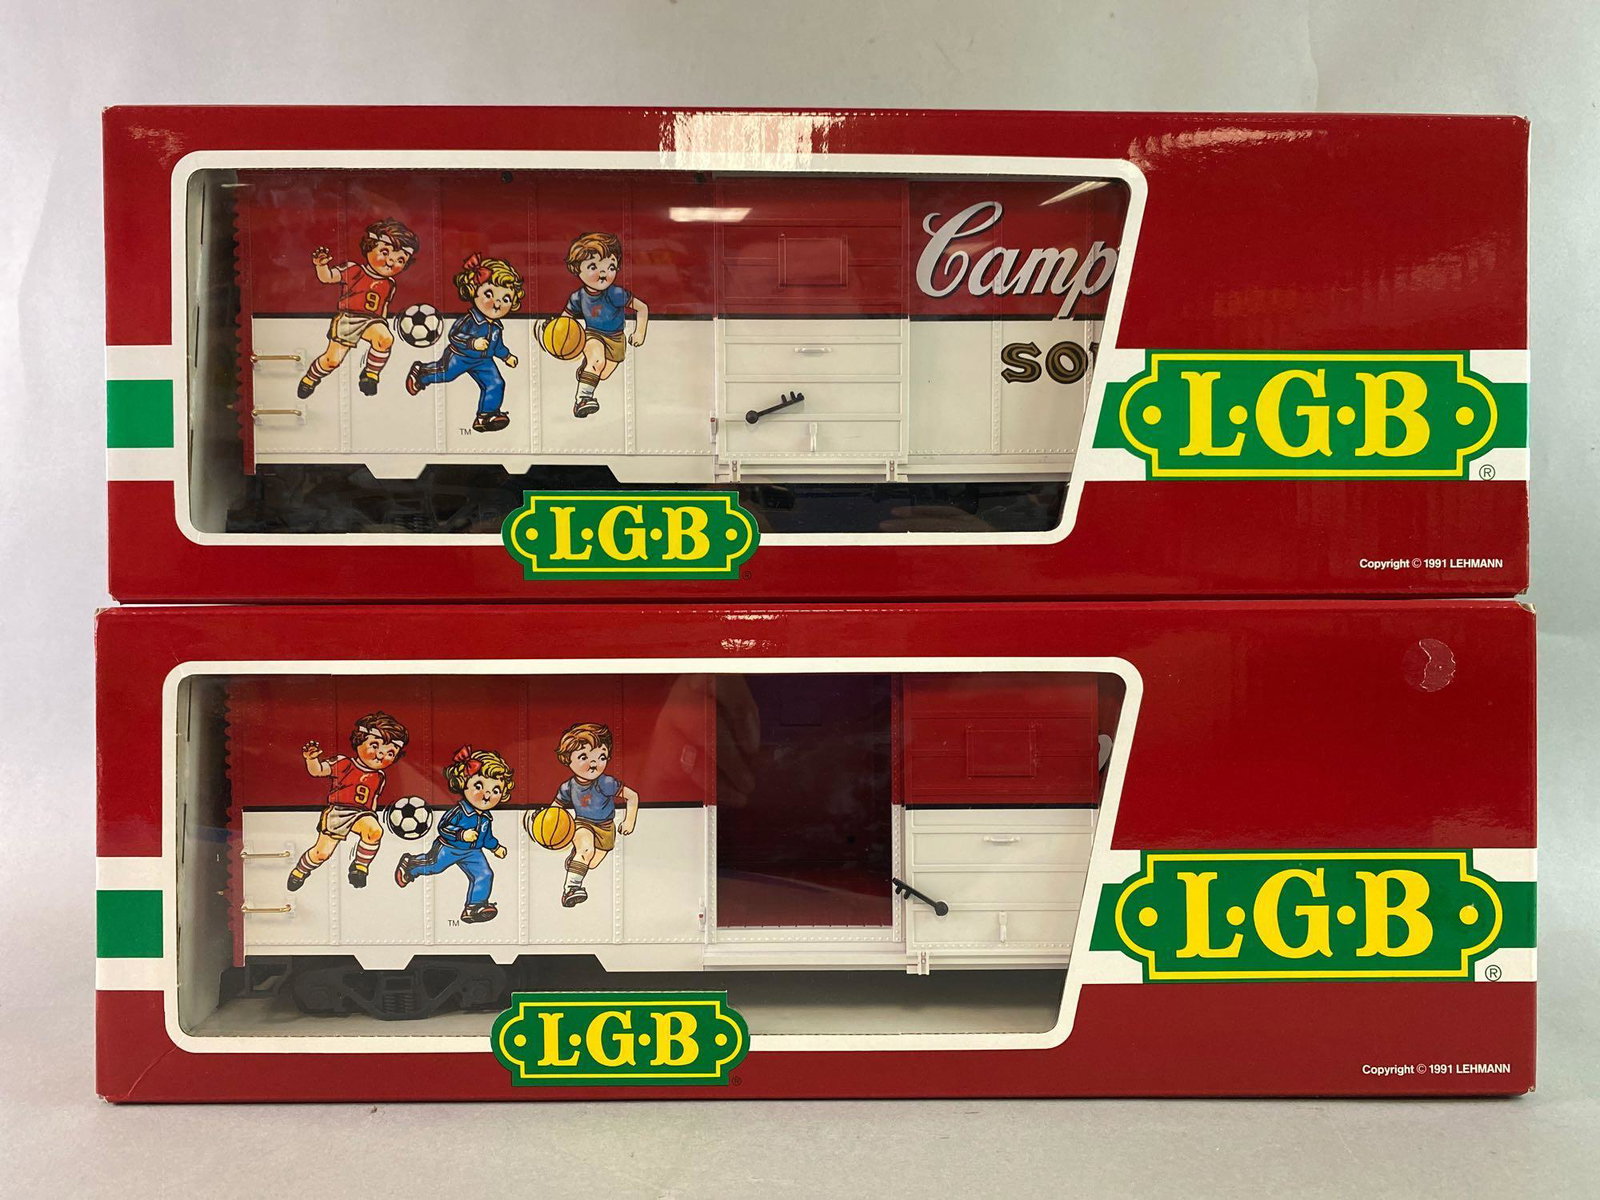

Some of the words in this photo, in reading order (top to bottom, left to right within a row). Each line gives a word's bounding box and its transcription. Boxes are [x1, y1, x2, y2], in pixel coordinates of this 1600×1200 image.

[365, 291, 380, 312] 9
[1000, 340, 1099, 385] SO
[1359, 558, 1410, 570] Copyright
[1424, 558, 1447, 568] 1991
[1450, 558, 1503, 568] LEHMANN
[355, 784, 370, 805] 9
[447, 919, 460, 927] TM
[1362, 1064, 1415, 1076] Copyright
[1429, 1064, 1453, 1074] 1991
[1456, 1063, 1511, 1074] LEHMANN
